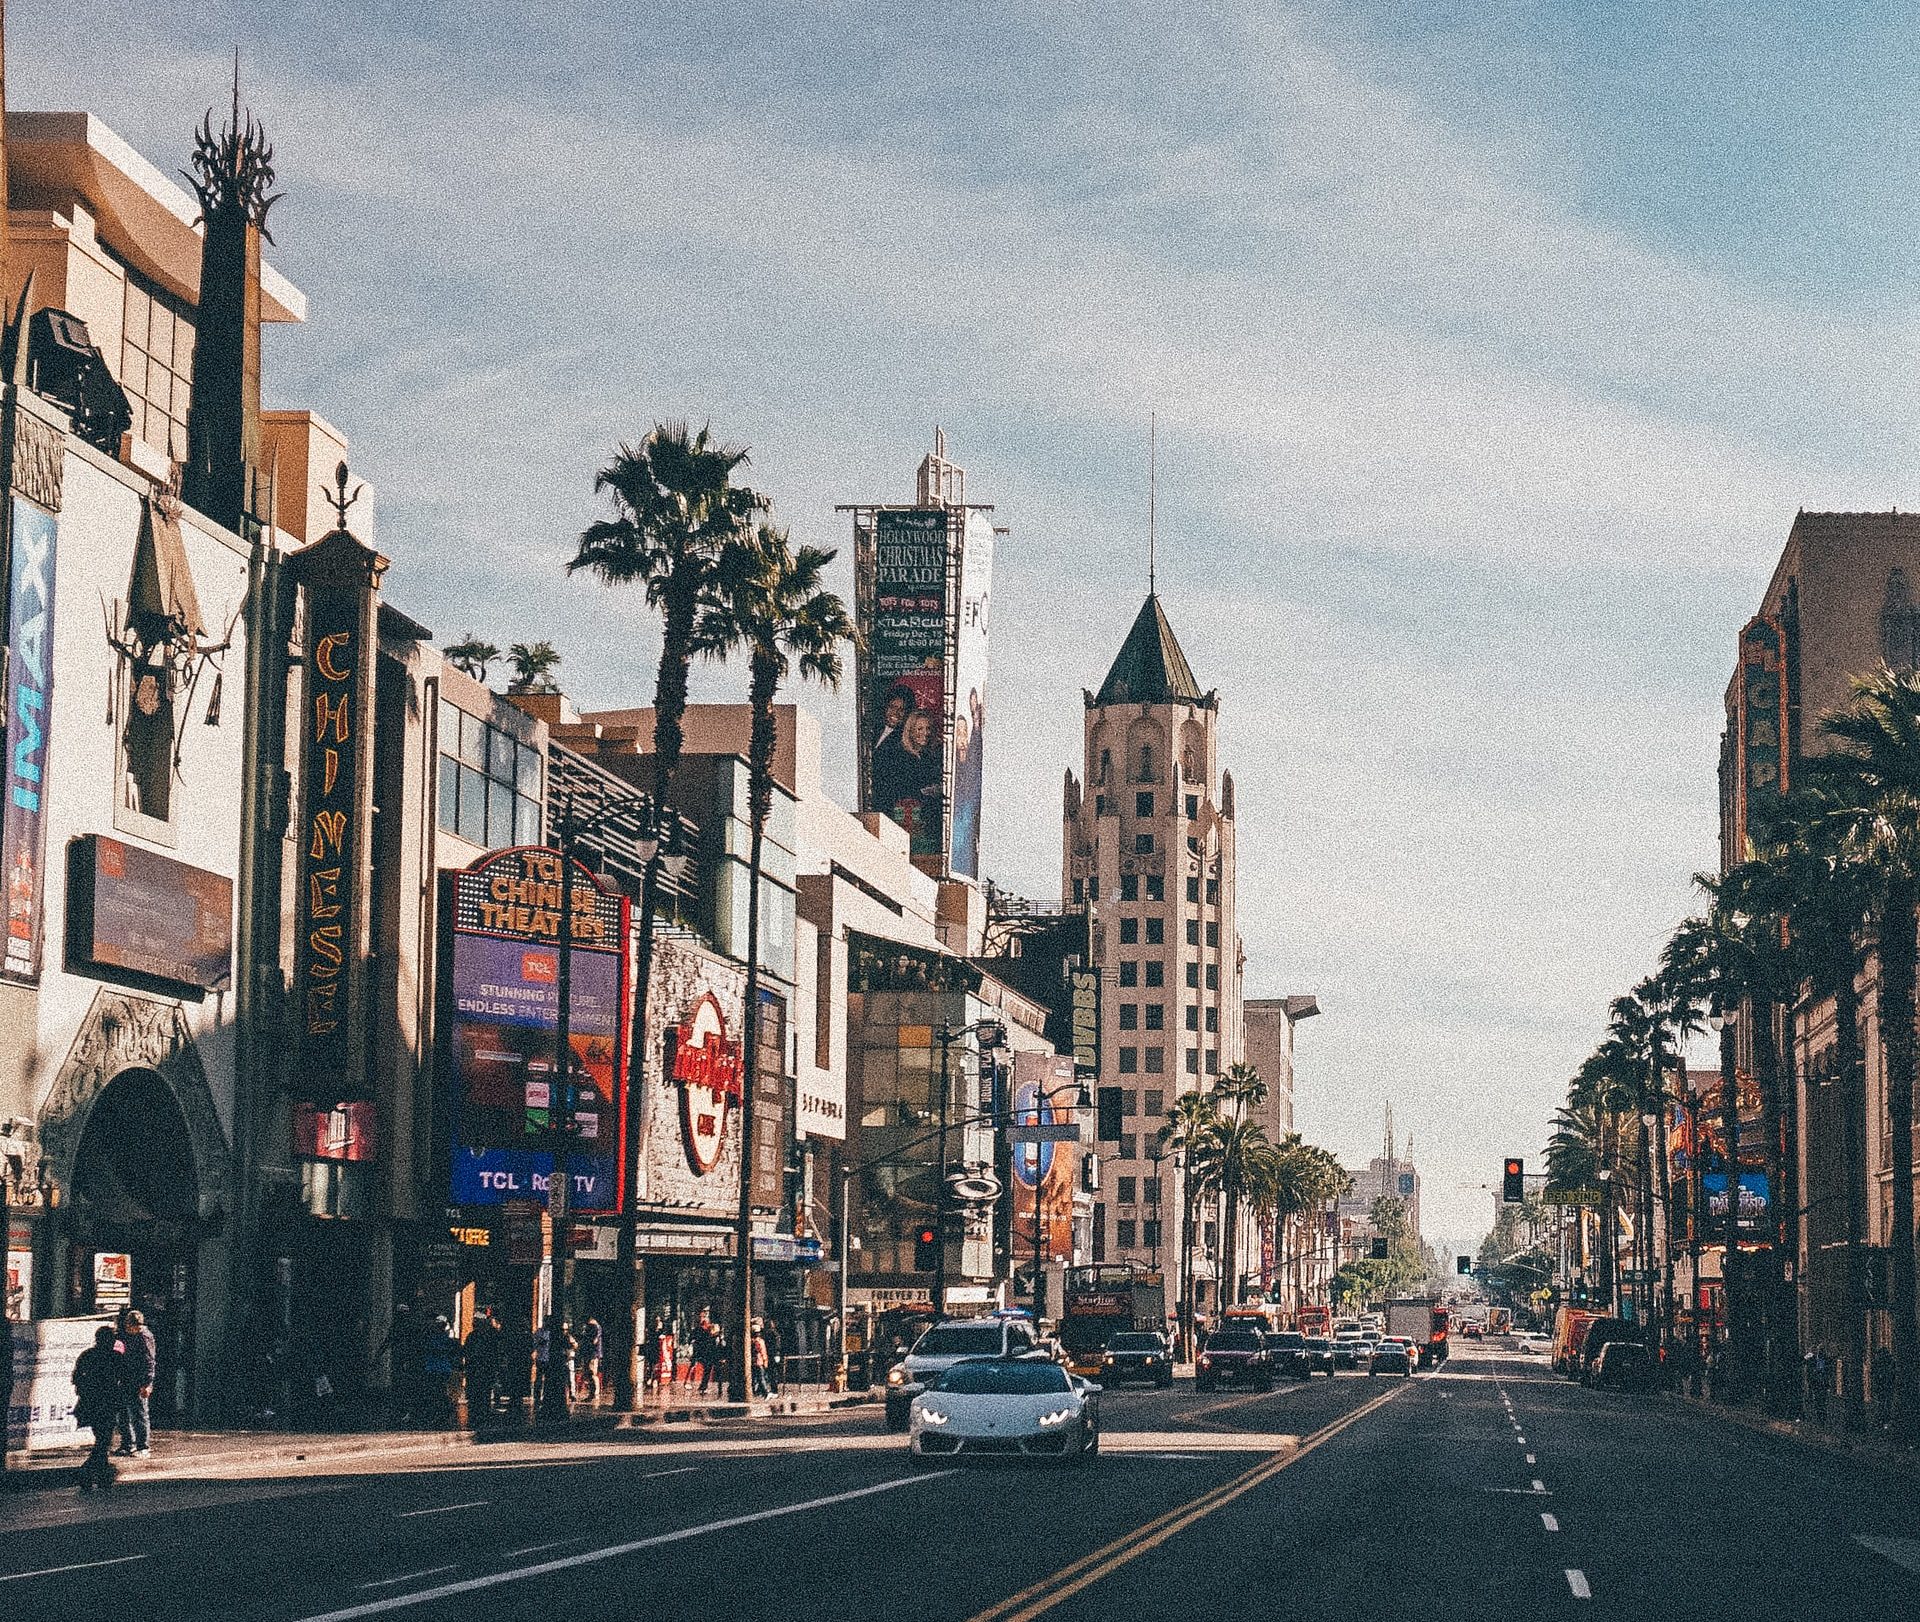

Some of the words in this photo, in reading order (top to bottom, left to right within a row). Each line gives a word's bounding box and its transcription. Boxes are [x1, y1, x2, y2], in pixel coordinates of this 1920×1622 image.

[878, 530, 945, 544] HOLLYWOOD
[878, 545, 943, 567] CHRISTMAS
[878, 568, 943, 582] PARADE
[13, 531, 48, 813] IMAX
[308, 632, 351, 1034] CHINESE
[528, 961, 552, 974] TCL
[480, 984, 545, 1002] STUNNING
[458, 999, 515, 1016] ENDLESS
[479, 1172, 519, 1190] TCL
[574, 1176, 595, 1193] TV
[871, 1290, 912, 1300] FOREVER
